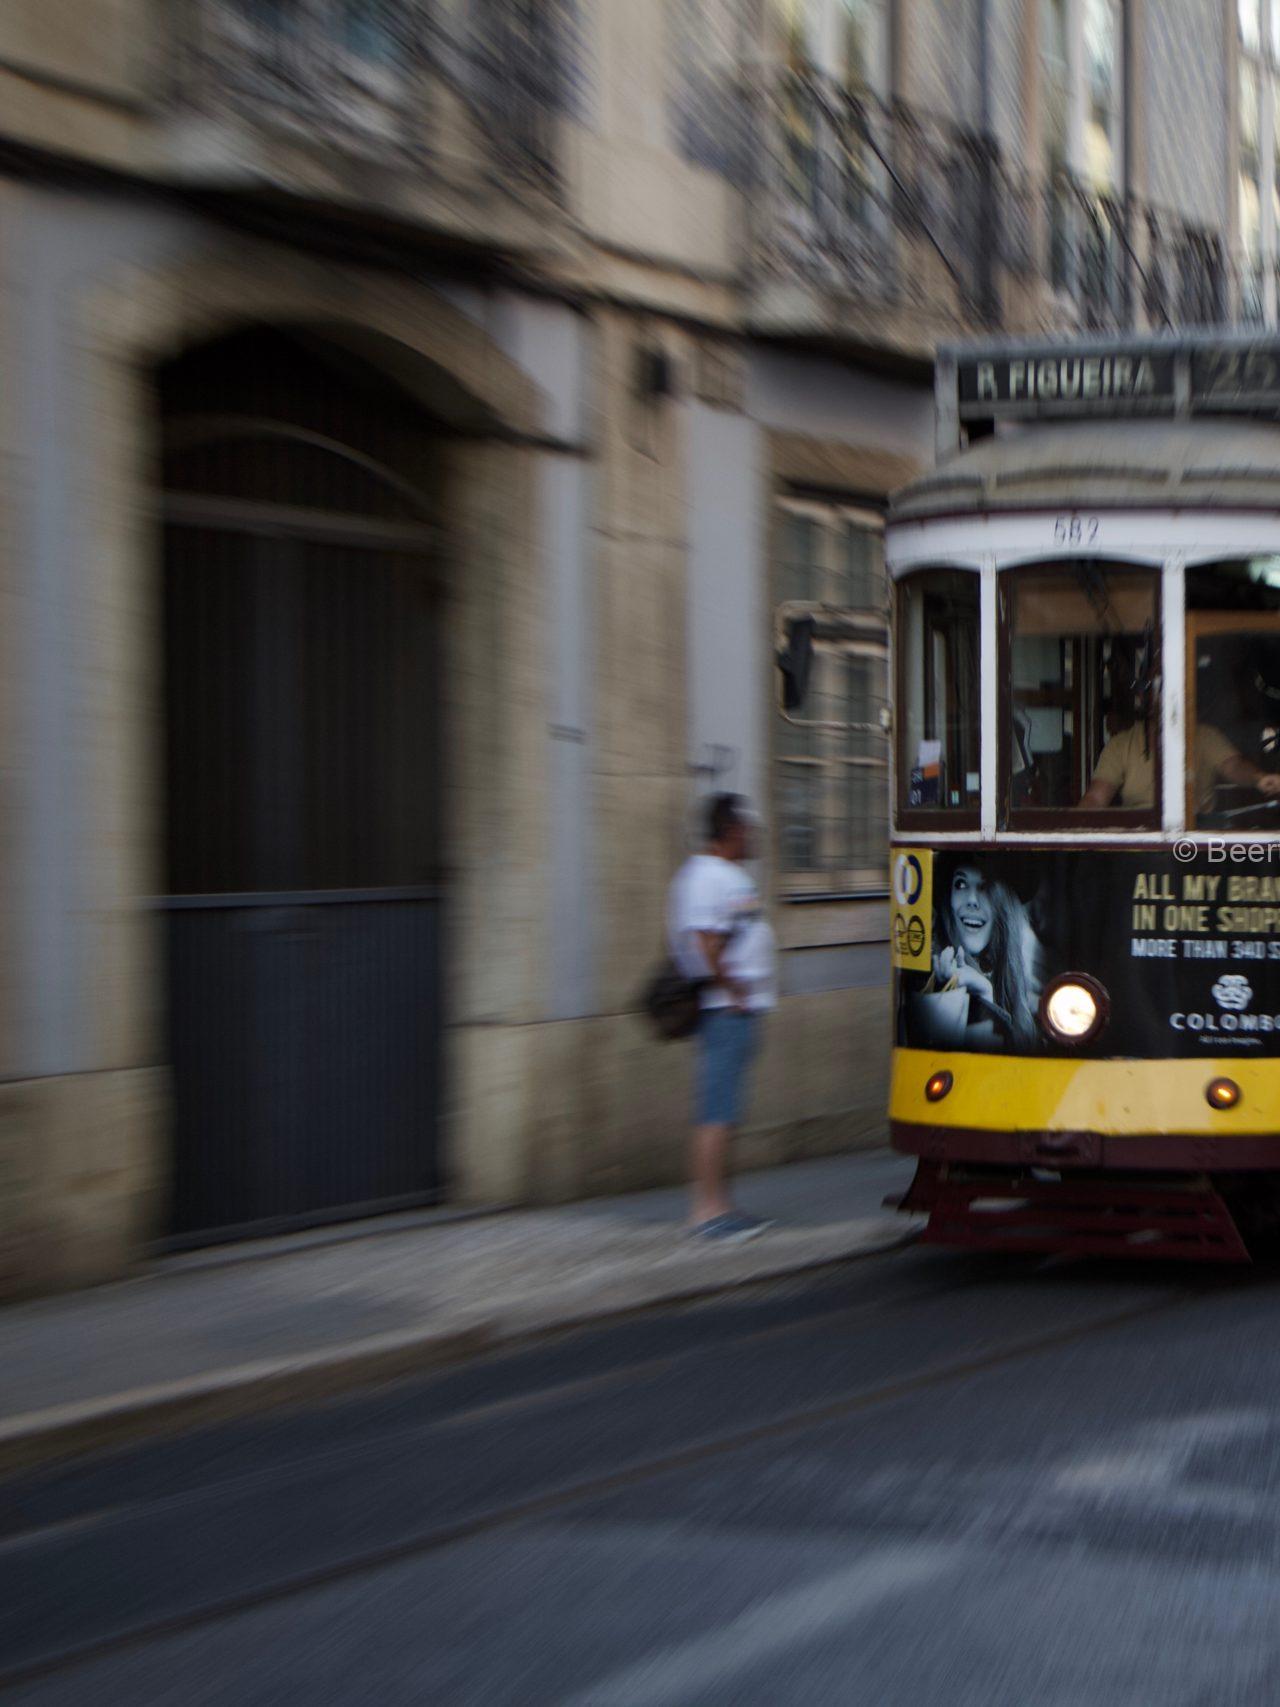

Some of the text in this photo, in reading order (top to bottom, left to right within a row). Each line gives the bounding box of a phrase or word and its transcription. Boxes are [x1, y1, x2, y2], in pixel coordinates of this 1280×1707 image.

[1009, 355, 1155, 401] FIGUEIRA
[1133, 873, 1176, 900] ALL
[1182, 875, 1222, 901] MY
[1132, 904, 1156, 931] IN
[1164, 905, 1210, 932] ONE
[1131, 938, 1177, 958] MORE
[1183, 939, 1228, 959] THAN
